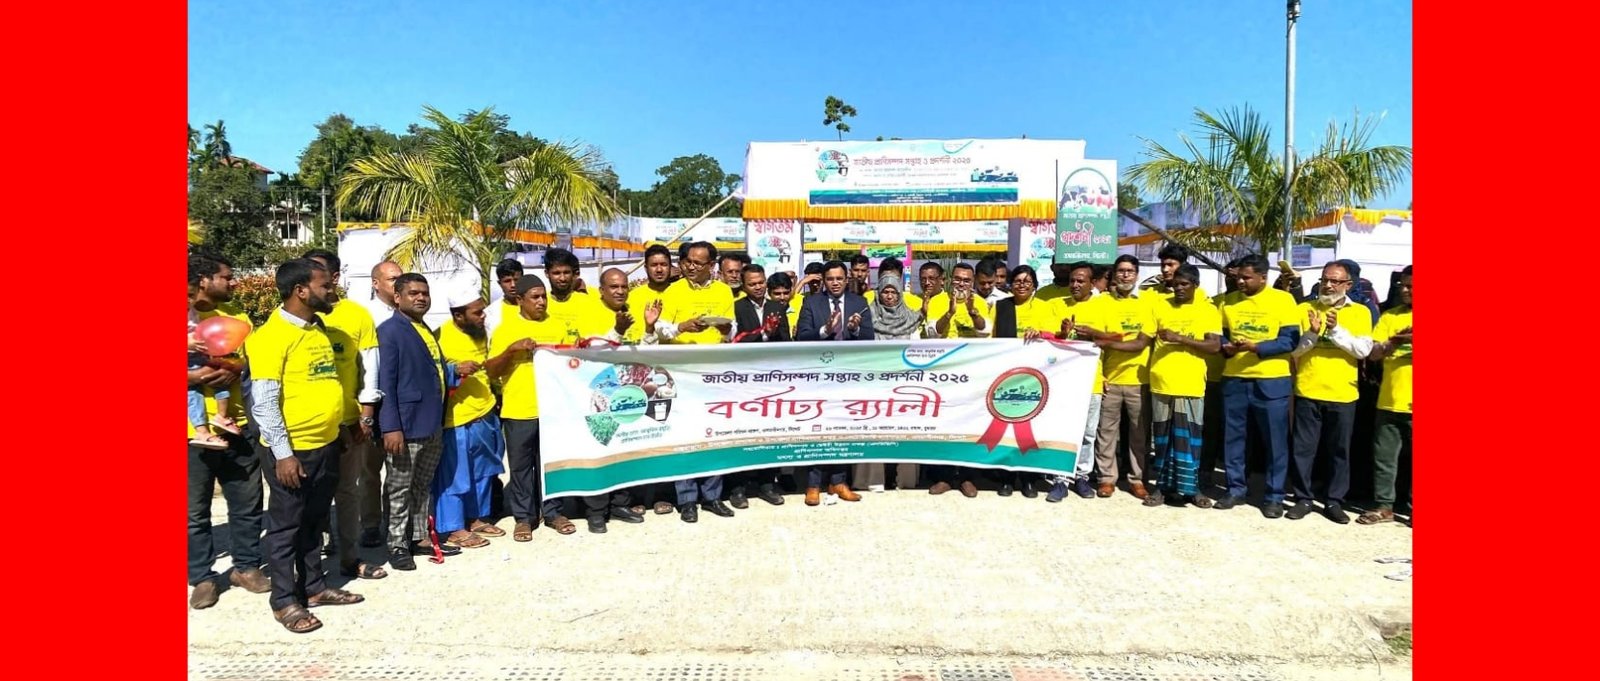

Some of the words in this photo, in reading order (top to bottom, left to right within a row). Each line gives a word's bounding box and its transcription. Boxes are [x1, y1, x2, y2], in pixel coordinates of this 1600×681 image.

[753, 219, 794, 234] স্বাগতম
[1030, 220, 1056, 235] স্বাগ
[702, 370, 748, 384] জাতীয়
[752, 369, 820, 383] প্রাণিসম্পদ
[824, 372, 861, 383] সপ্তাহ
[864, 373, 875, 382] ও
[878, 369, 925, 383] প্রদর্শনী
[928, 373, 970, 384] ২০২৫
[705, 386, 828, 422] বর্ণাঢ্য
